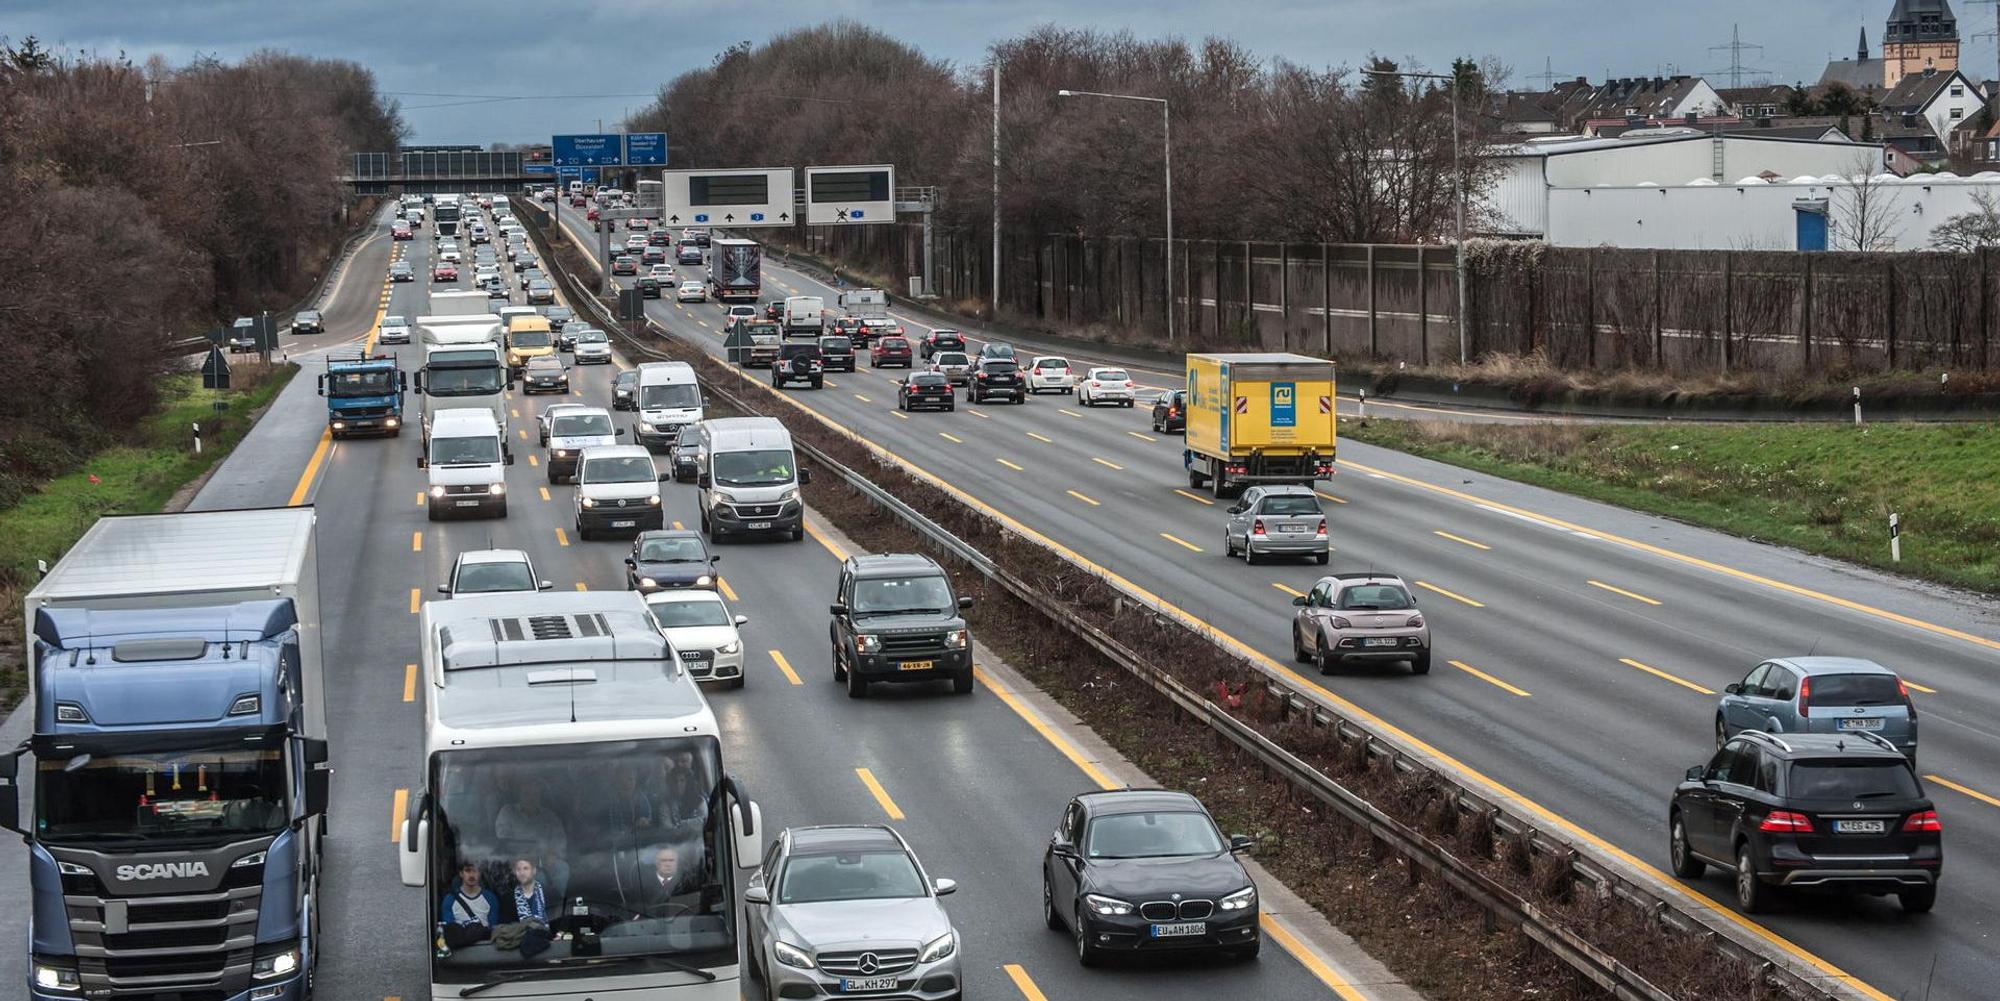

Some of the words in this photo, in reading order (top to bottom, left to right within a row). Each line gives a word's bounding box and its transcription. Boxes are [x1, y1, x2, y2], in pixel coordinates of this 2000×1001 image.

[116, 861, 209, 880] SCANIA
[1185, 924, 1205, 934] 1806
[847, 980, 860, 990] GL
[864, 979, 878, 989] KH
[879, 978, 896, 988] 297
